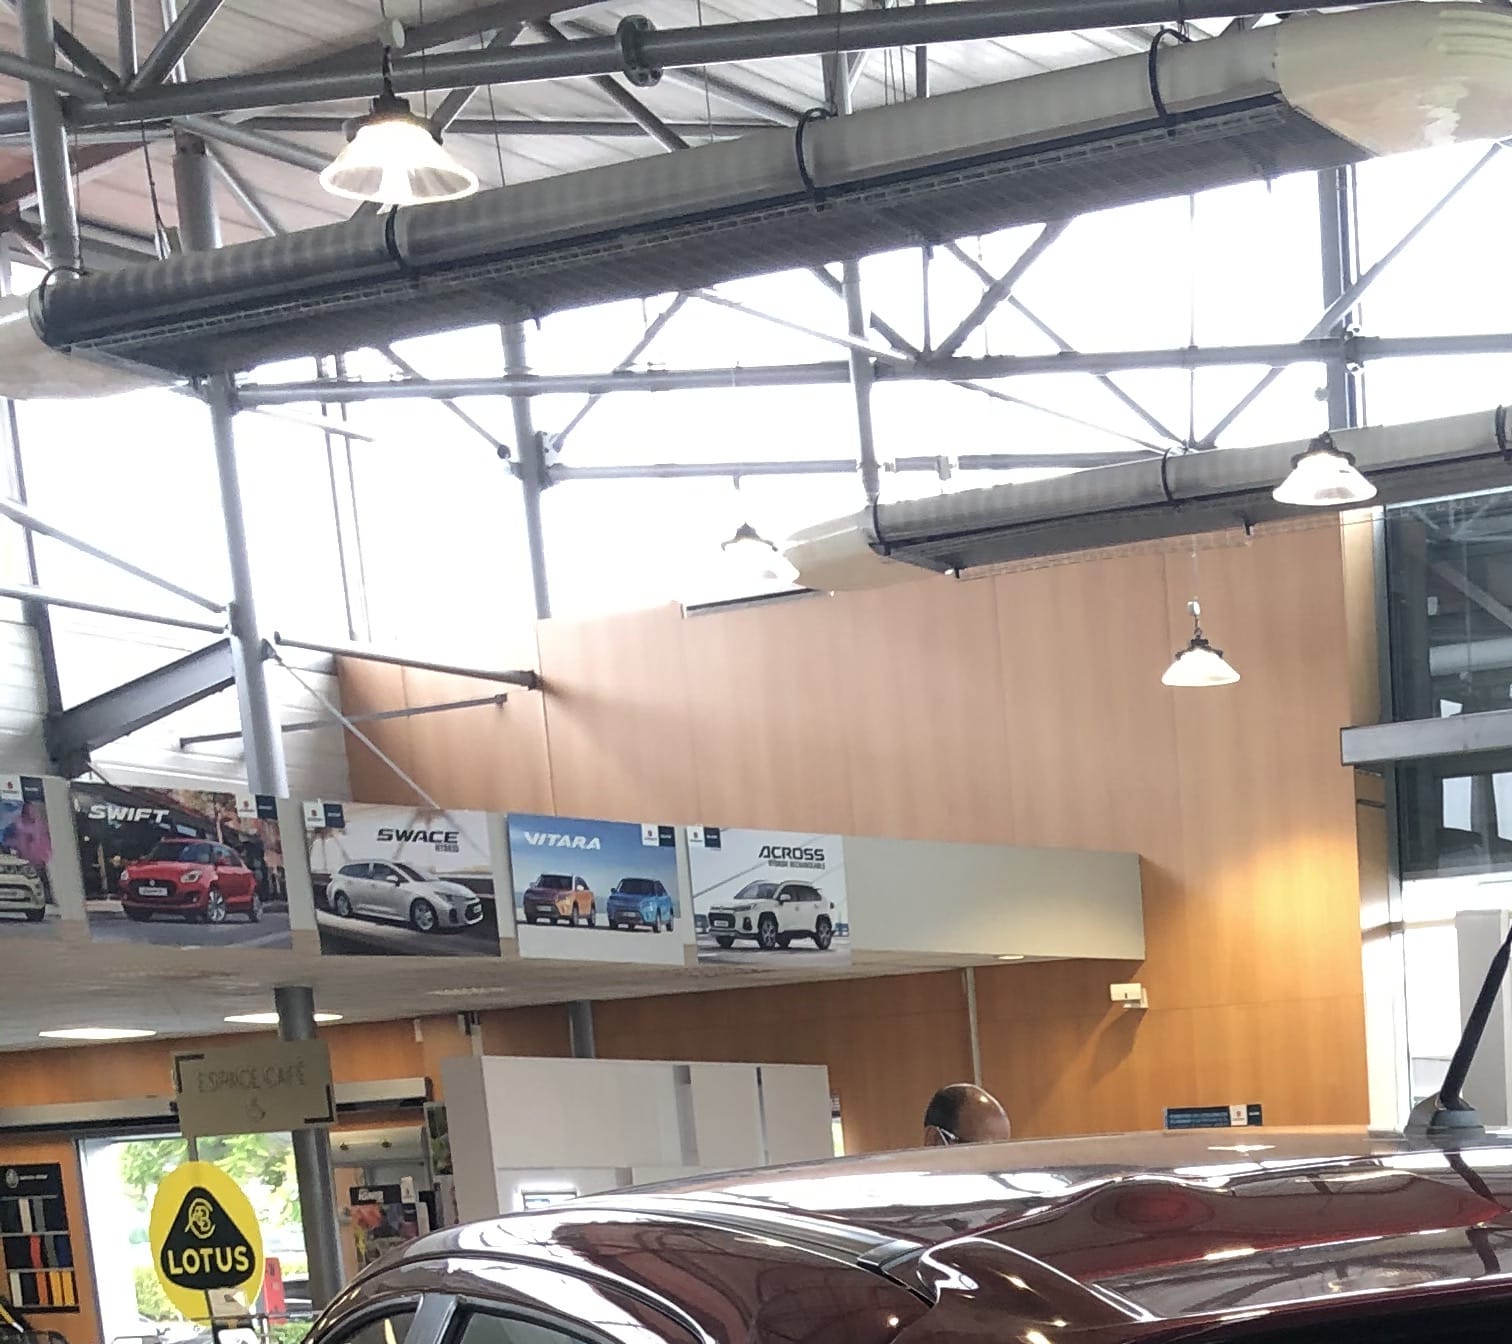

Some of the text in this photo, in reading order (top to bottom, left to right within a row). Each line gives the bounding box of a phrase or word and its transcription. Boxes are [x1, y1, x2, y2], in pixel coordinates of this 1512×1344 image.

[88, 804, 170, 824] SWIFT
[376, 828, 460, 844] SWACE
[524, 831, 602, 851] VITARA
[758, 845, 825, 862] ACROSS
[196, 1056, 306, 1093] ESPACE CAFÉ
[168, 1245, 250, 1276] LOTUS
